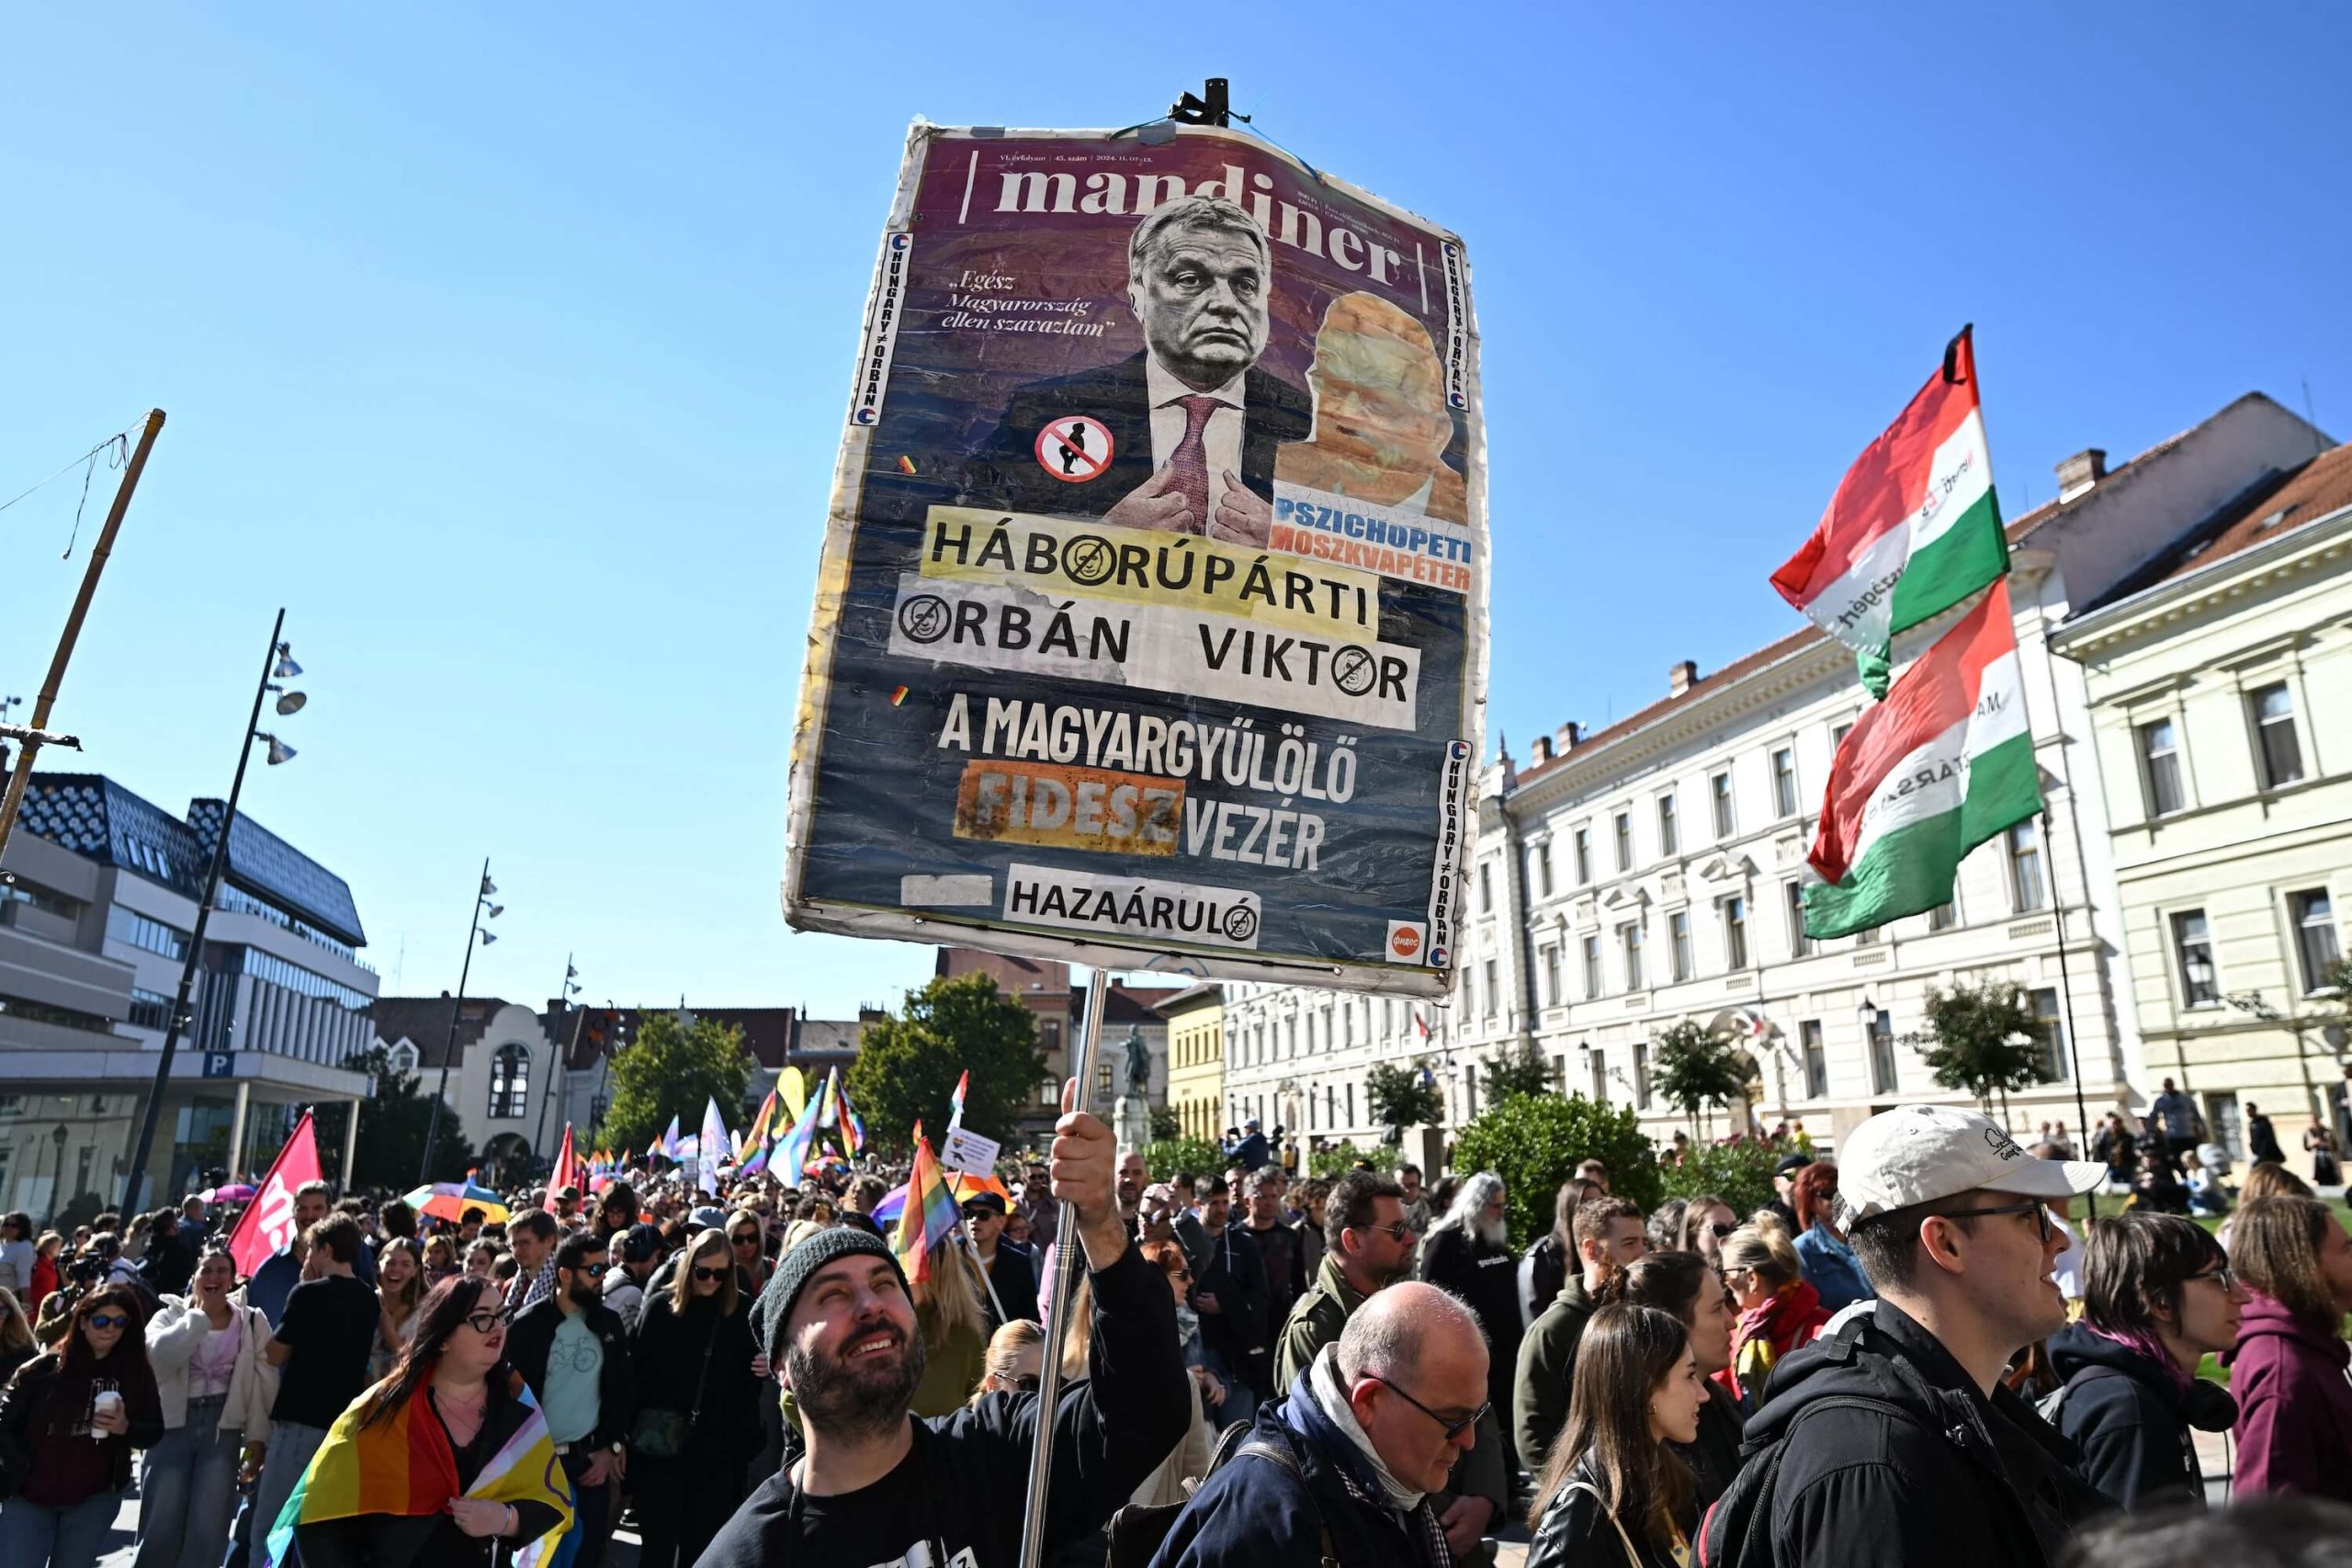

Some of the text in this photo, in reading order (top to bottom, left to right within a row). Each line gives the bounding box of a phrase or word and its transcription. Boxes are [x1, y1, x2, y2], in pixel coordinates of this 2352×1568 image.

[993, 164, 1401, 287] mandiner
[880, 252, 902, 333] HUNGARY
[942, 311, 990, 330] ellen
[944, 293, 1092, 317] Magyarország
[864, 344, 885, 406] ORBAN
[1269, 525, 1471, 591] MOSZKVAPÉTER
[1275, 497, 1472, 564] PSZICHOPETI
[932, 517, 1366, 626] HÁBORÚPÁRTI
[898, 594, 1408, 703] ORBÁN VIKTOR
[937, 693, 1358, 805] A MAGYARGYŰLÖLŐ
[975, 772, 1326, 872] FIDESZ VEZÉR
[1443, 761, 1460, 860] HUNGARY
[1012, 880, 1258, 942] HAZAÁRULÓ
[1393, 932, 1419, 948] фидес
[1435, 875, 1450, 945] ORBAN
[211, 1055, 228, 1075] P
